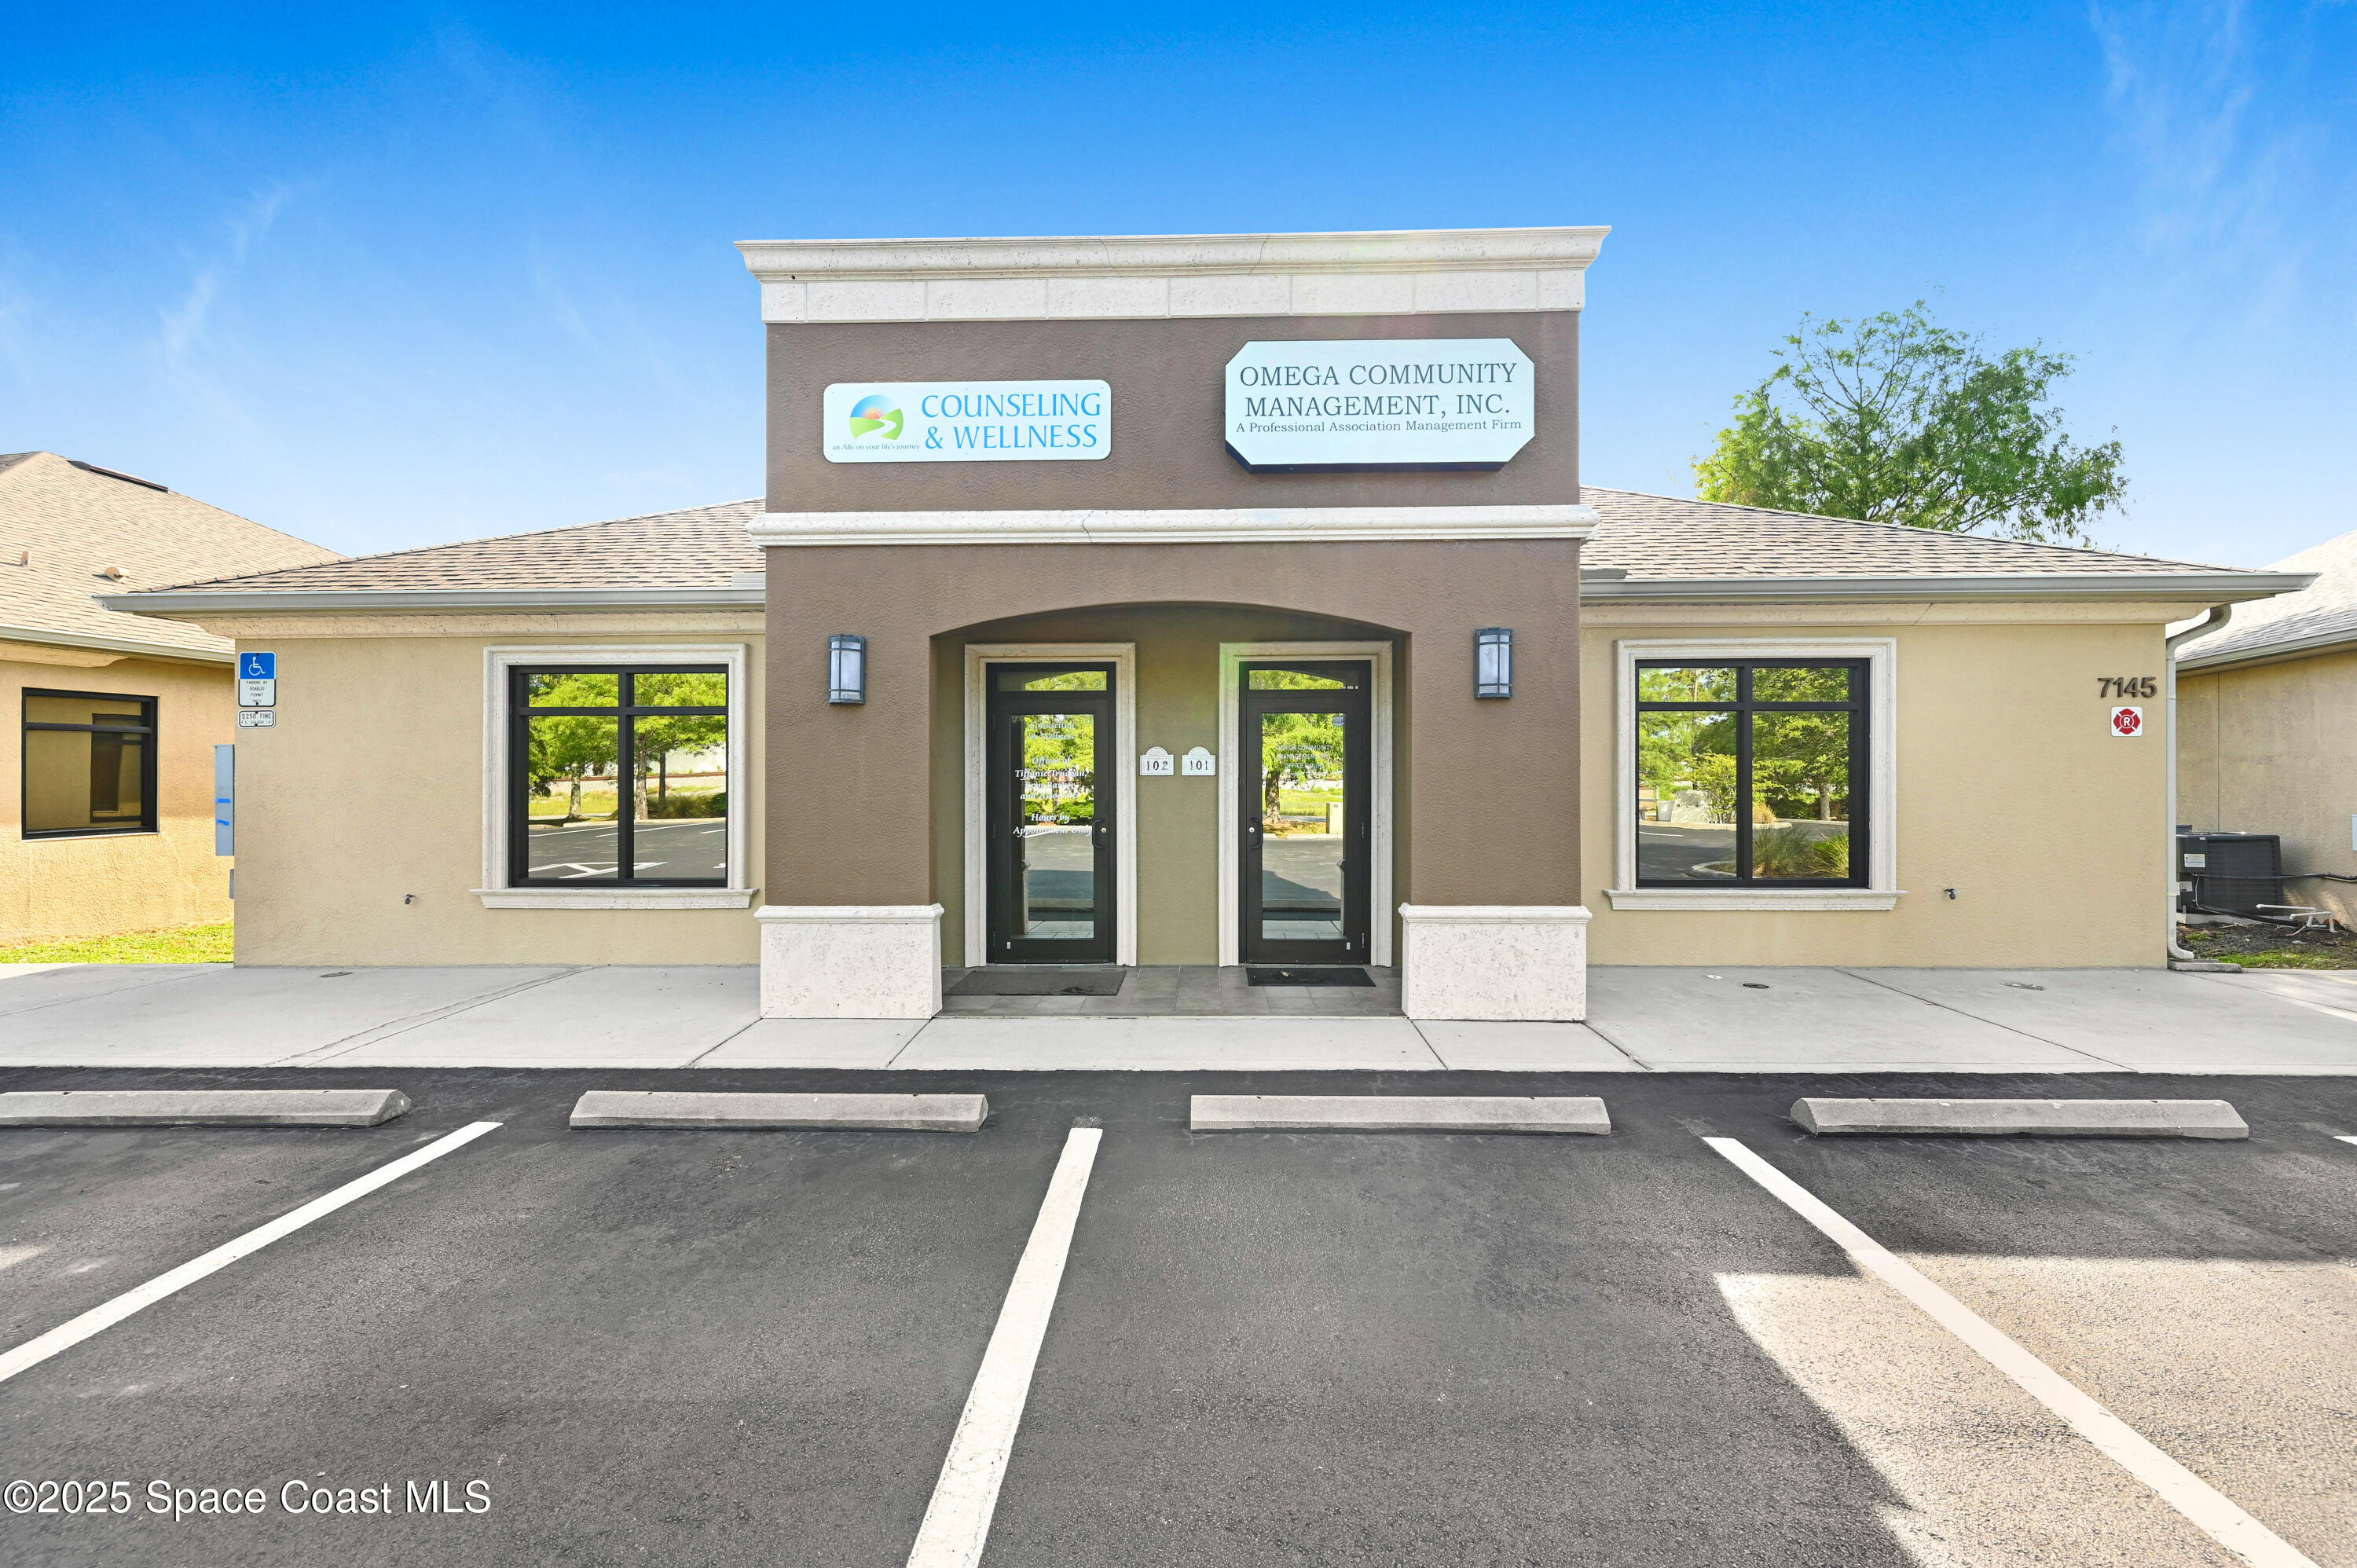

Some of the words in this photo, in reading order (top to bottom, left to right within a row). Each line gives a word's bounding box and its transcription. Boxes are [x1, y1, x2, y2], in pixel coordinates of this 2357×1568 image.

[1240, 365, 1340, 387] OMEGA
[1349, 362, 1518, 385] COMMUNITY
[922, 393, 1101, 418] COUNSELING
[1245, 394, 1446, 419] MANAGEMENT,
[1456, 394, 1510, 415] INC.
[1236, 422, 1245, 432] A
[1249, 421, 1325, 432] Professional
[1329, 421, 1401, 431] Association
[1406, 420, 1488, 433] Management
[1491, 419, 1522, 430] Firm
[925, 426, 943, 450] &
[953, 424, 1098, 449] WELLNESS
[2097, 676, 2157, 698] 7145
[2123, 716, 2131, 727] R
[1146, 760, 1168, 771] 102
[1189, 760, 1208, 770] 101
[1031, 813, 1057, 822] Hours
[1059, 811, 1070, 824] by
